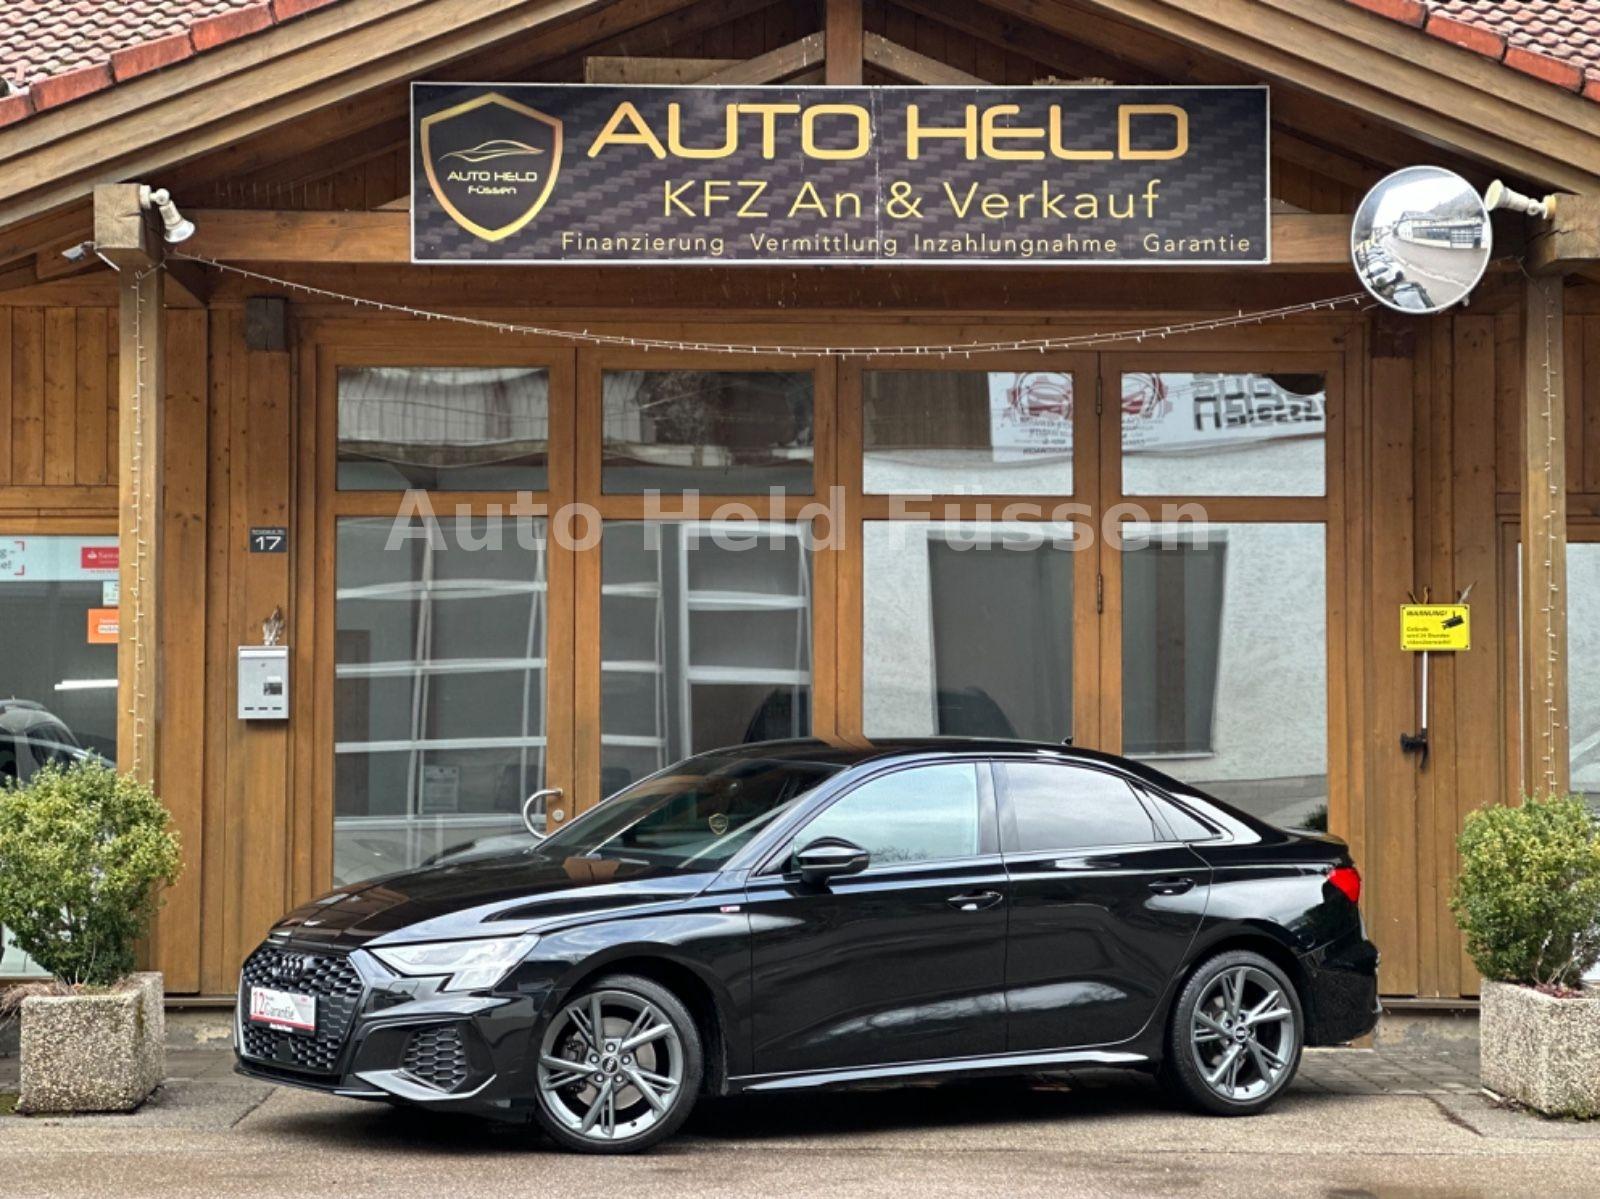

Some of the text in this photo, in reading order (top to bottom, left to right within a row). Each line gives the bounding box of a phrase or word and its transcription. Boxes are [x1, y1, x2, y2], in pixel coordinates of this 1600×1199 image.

[587, 101, 1189, 160] AUTO HELD
[447, 170, 538, 182] AUTO HELD
[468, 184, 517, 195] Füssen
[664, 179, 1161, 219] KFZ An & Verkauf
[561, 232, 1250, 257] Finanzierung Vermittlung Inzahlungnahme Garantie
[255, 535, 282, 550] 17
[253, 991, 265, 1015] 12
